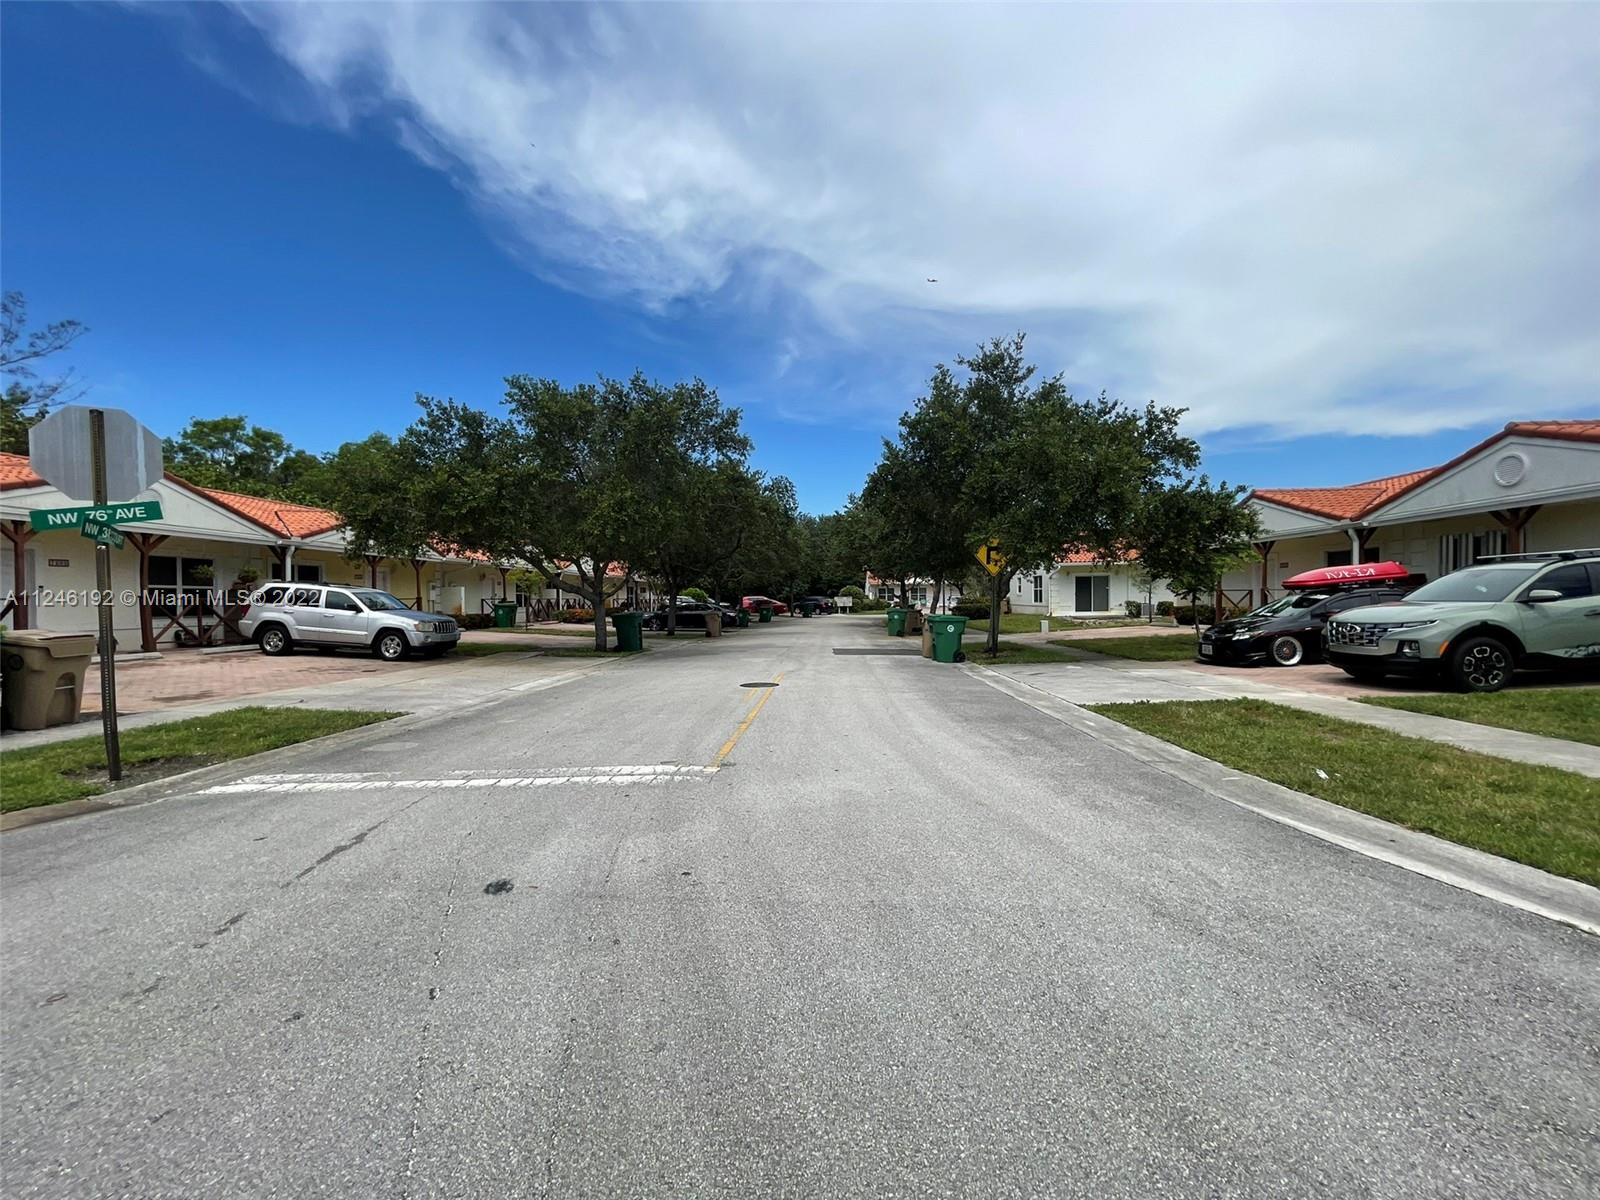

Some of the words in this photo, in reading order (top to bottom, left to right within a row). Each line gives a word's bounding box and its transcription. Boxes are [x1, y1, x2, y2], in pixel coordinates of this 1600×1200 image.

[47, 512, 78, 525] NW
[115, 507, 147, 520] AVE
[84, 522, 99, 536] NW
